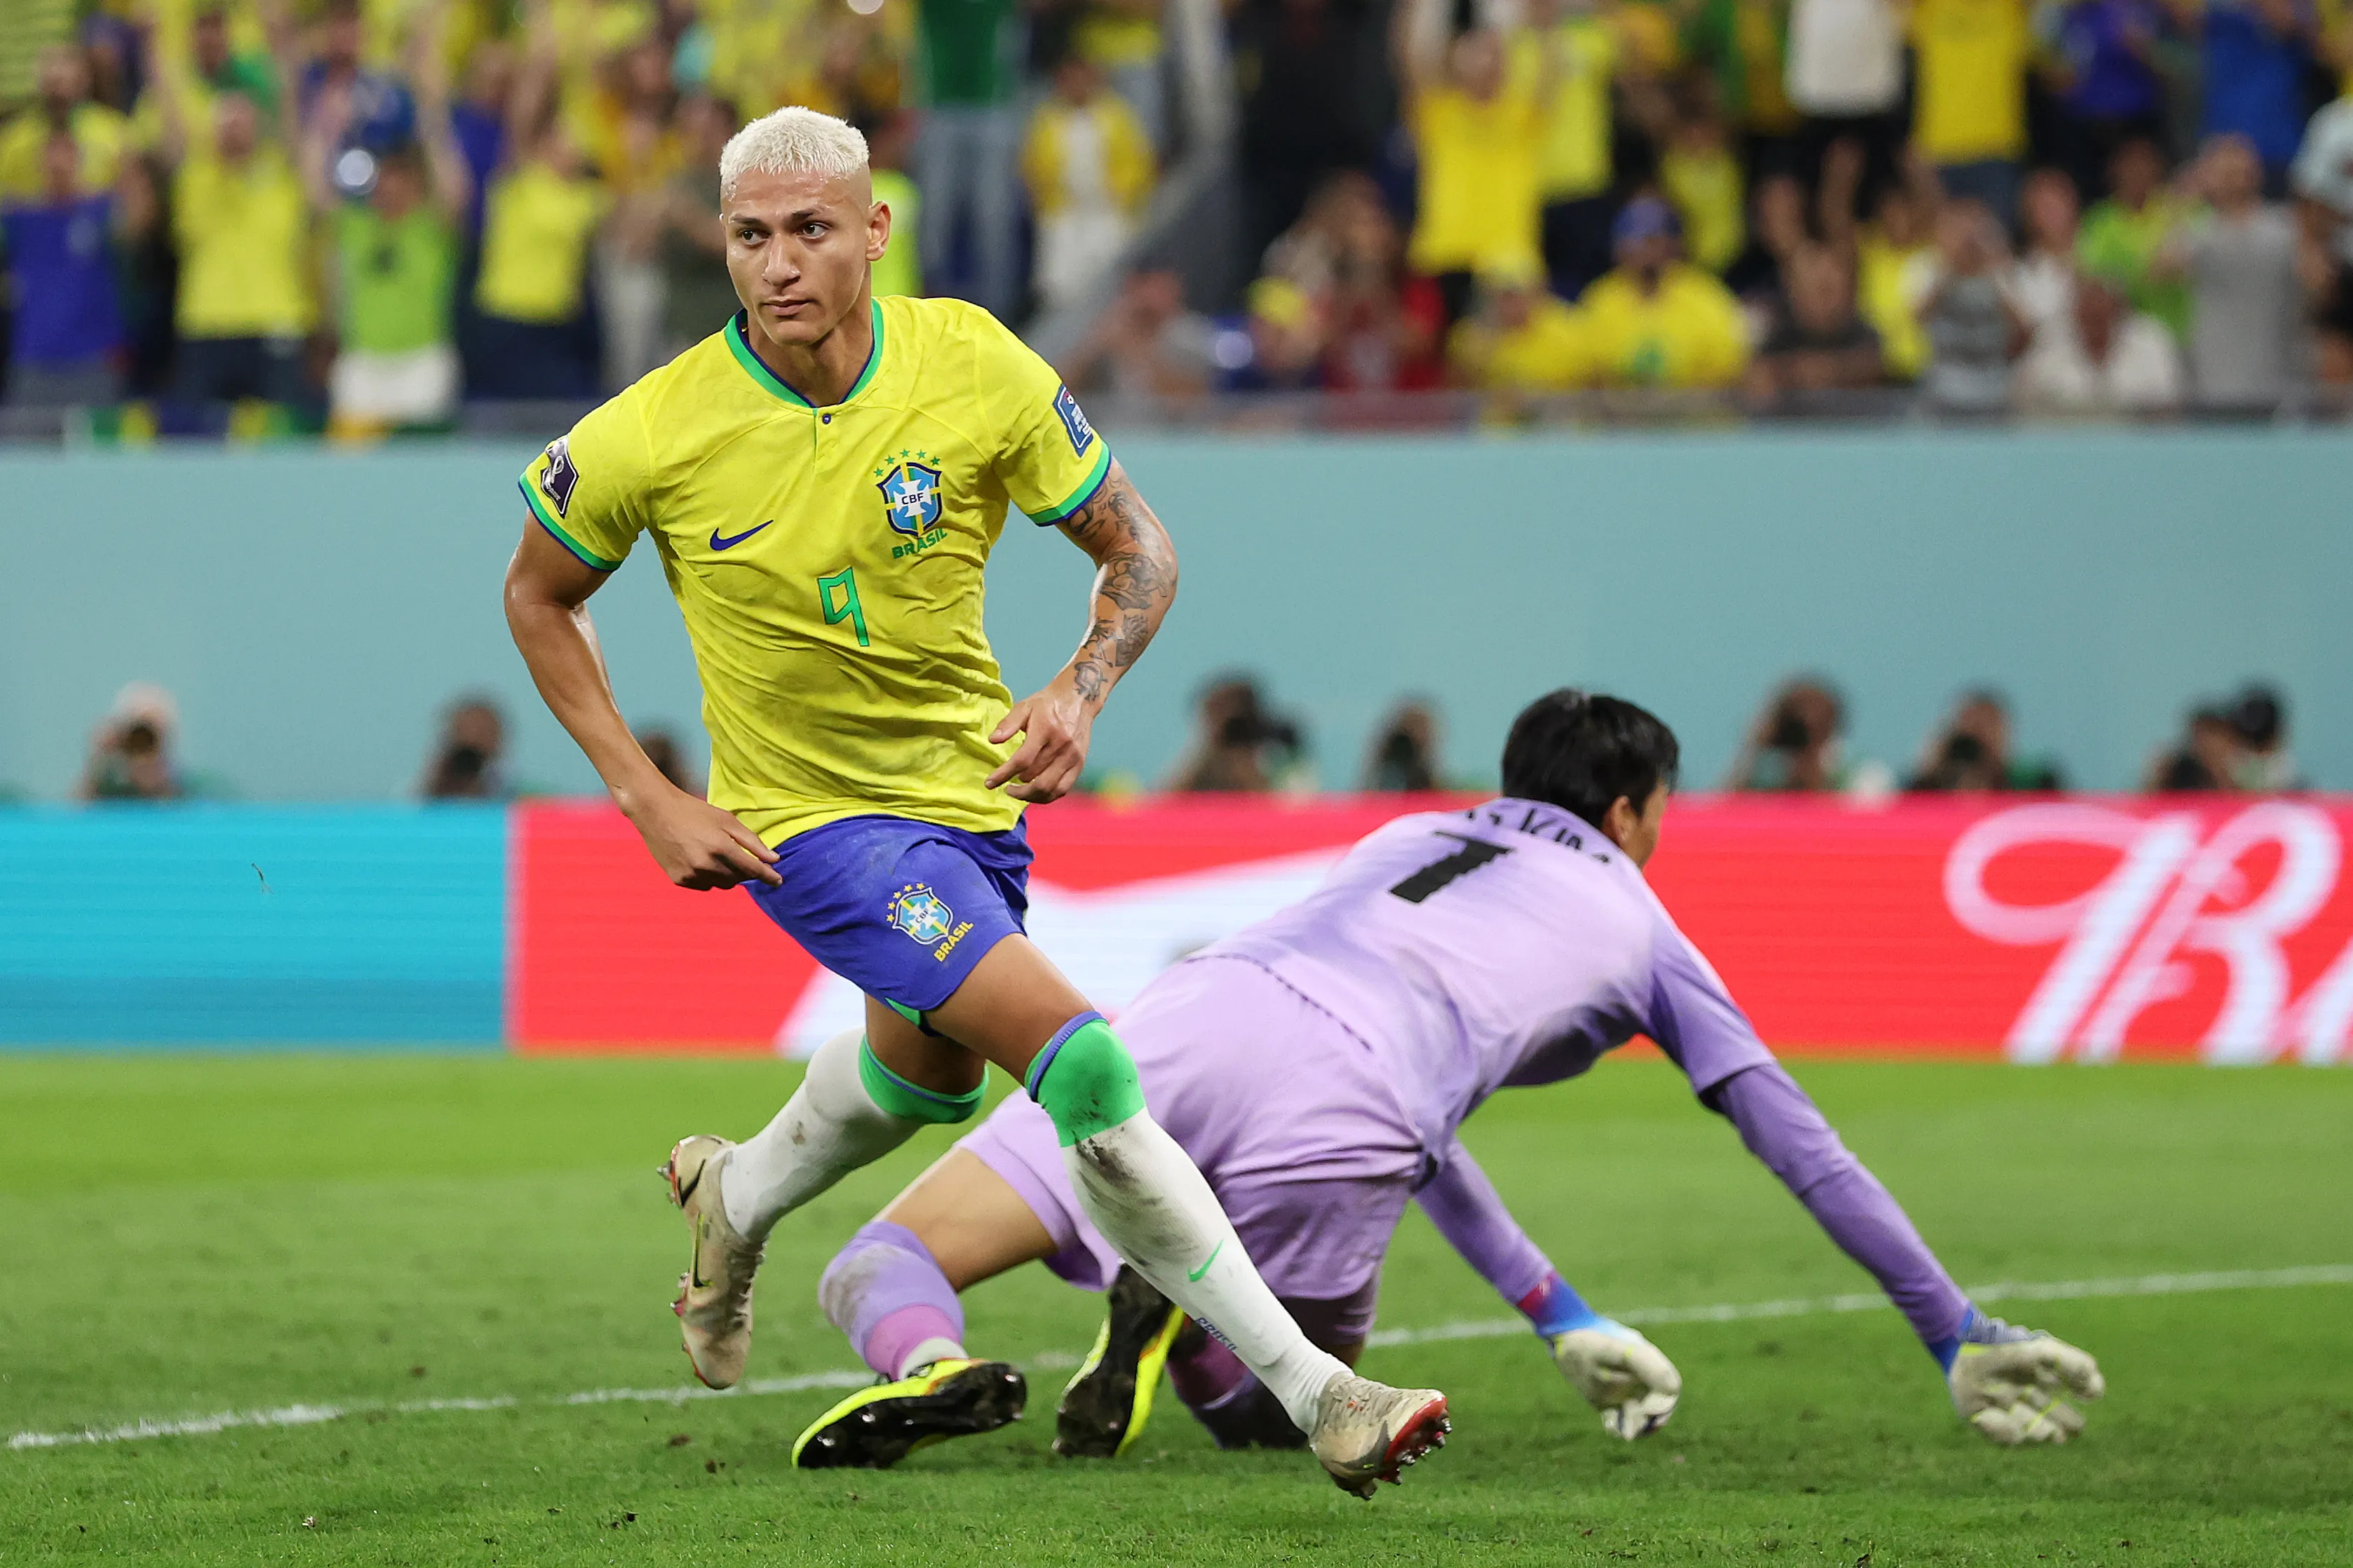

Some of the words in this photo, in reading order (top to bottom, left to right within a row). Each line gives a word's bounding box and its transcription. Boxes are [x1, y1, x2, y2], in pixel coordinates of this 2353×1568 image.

[901, 492, 924, 505] CBF
[891, 527, 948, 559] BRASIL
[817, 567, 870, 647] 9
[915, 908, 929, 924] CBF
[933, 921, 975, 962] BRASIL
